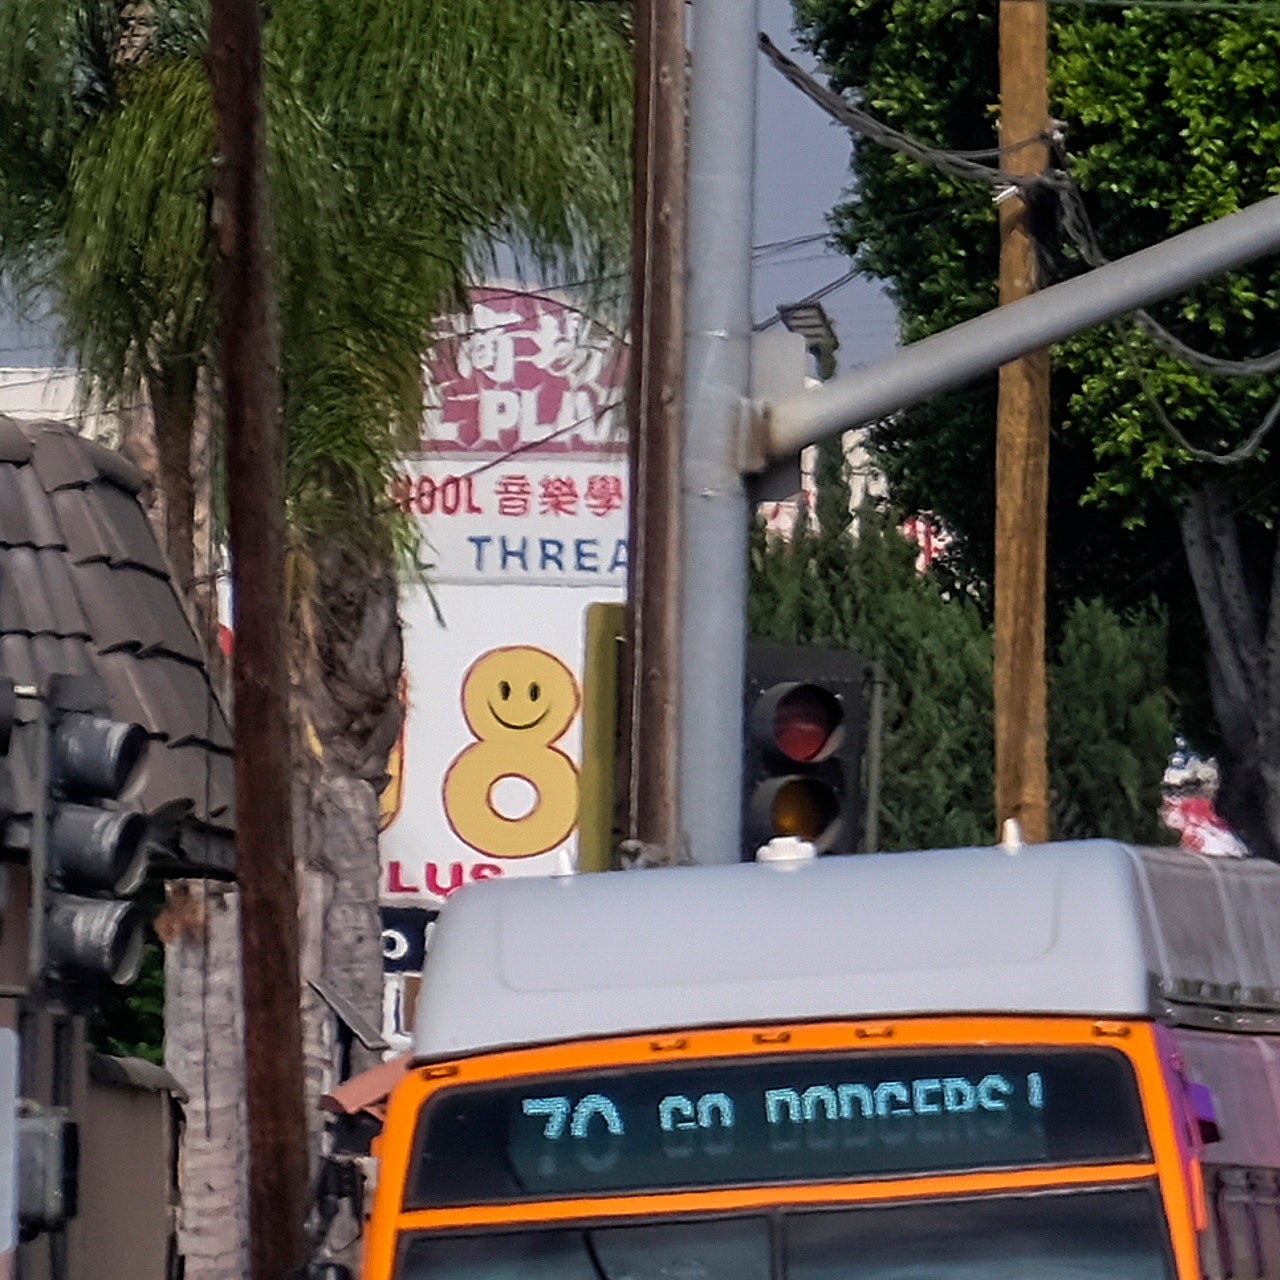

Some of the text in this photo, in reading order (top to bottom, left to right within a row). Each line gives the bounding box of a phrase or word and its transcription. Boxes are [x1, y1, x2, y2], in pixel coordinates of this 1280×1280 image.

[479, 388, 630, 442] PLA
[379, 644, 581, 858] 8
[522, 1093, 624, 1170] 70
